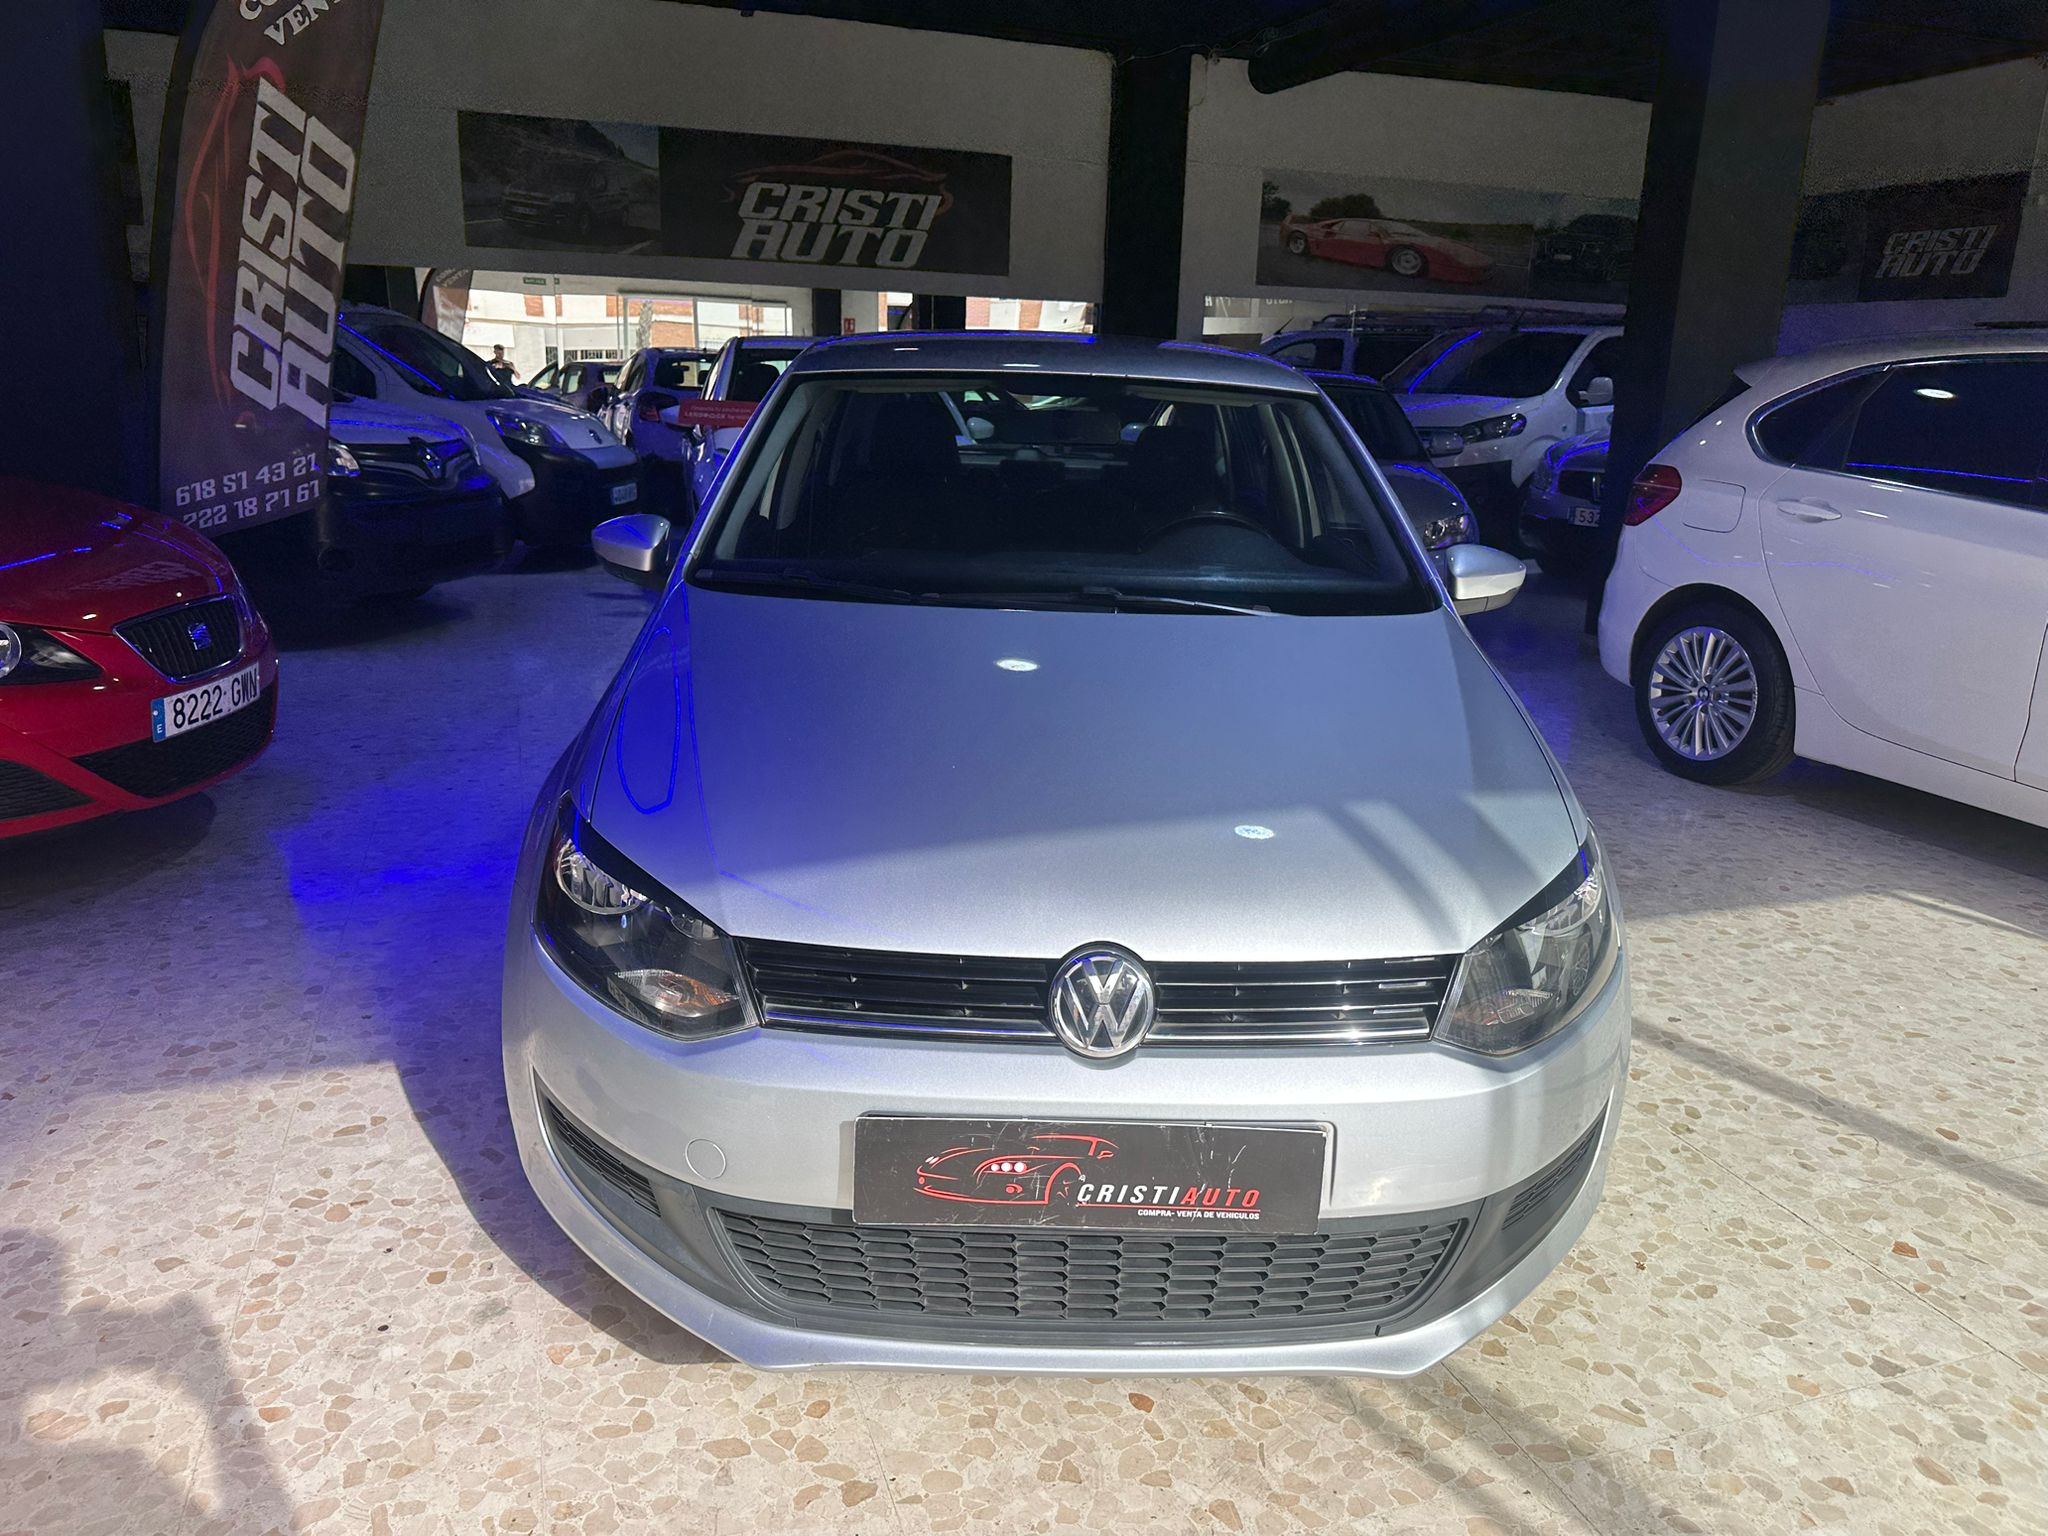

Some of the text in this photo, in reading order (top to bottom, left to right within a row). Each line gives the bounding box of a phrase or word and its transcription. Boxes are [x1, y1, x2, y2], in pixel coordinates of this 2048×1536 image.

[738, 182, 943, 231] CRISTI
[231, 76, 306, 411] CRISTI
[729, 217, 928, 268] AUTO
[1883, 224, 1998, 254] CRISTI
[280, 116, 355, 430] AUTO
[1875, 249, 1987, 278] AUTO
[176, 453, 317, 506] 618 51 43 21
[234, 497, 258, 519] 18
[297, 480, 320, 503] 61
[173, 668, 258, 729] 8222 GWN
[156, 723, 163, 734] E
[1077, 1183, 1260, 1208] CRISTIAUTO
[1176, 1210, 1203, 1218] VENTA
[1203, 1211, 1215, 1219] DE
[1215, 1211, 1260, 1220] VEHICULOS
